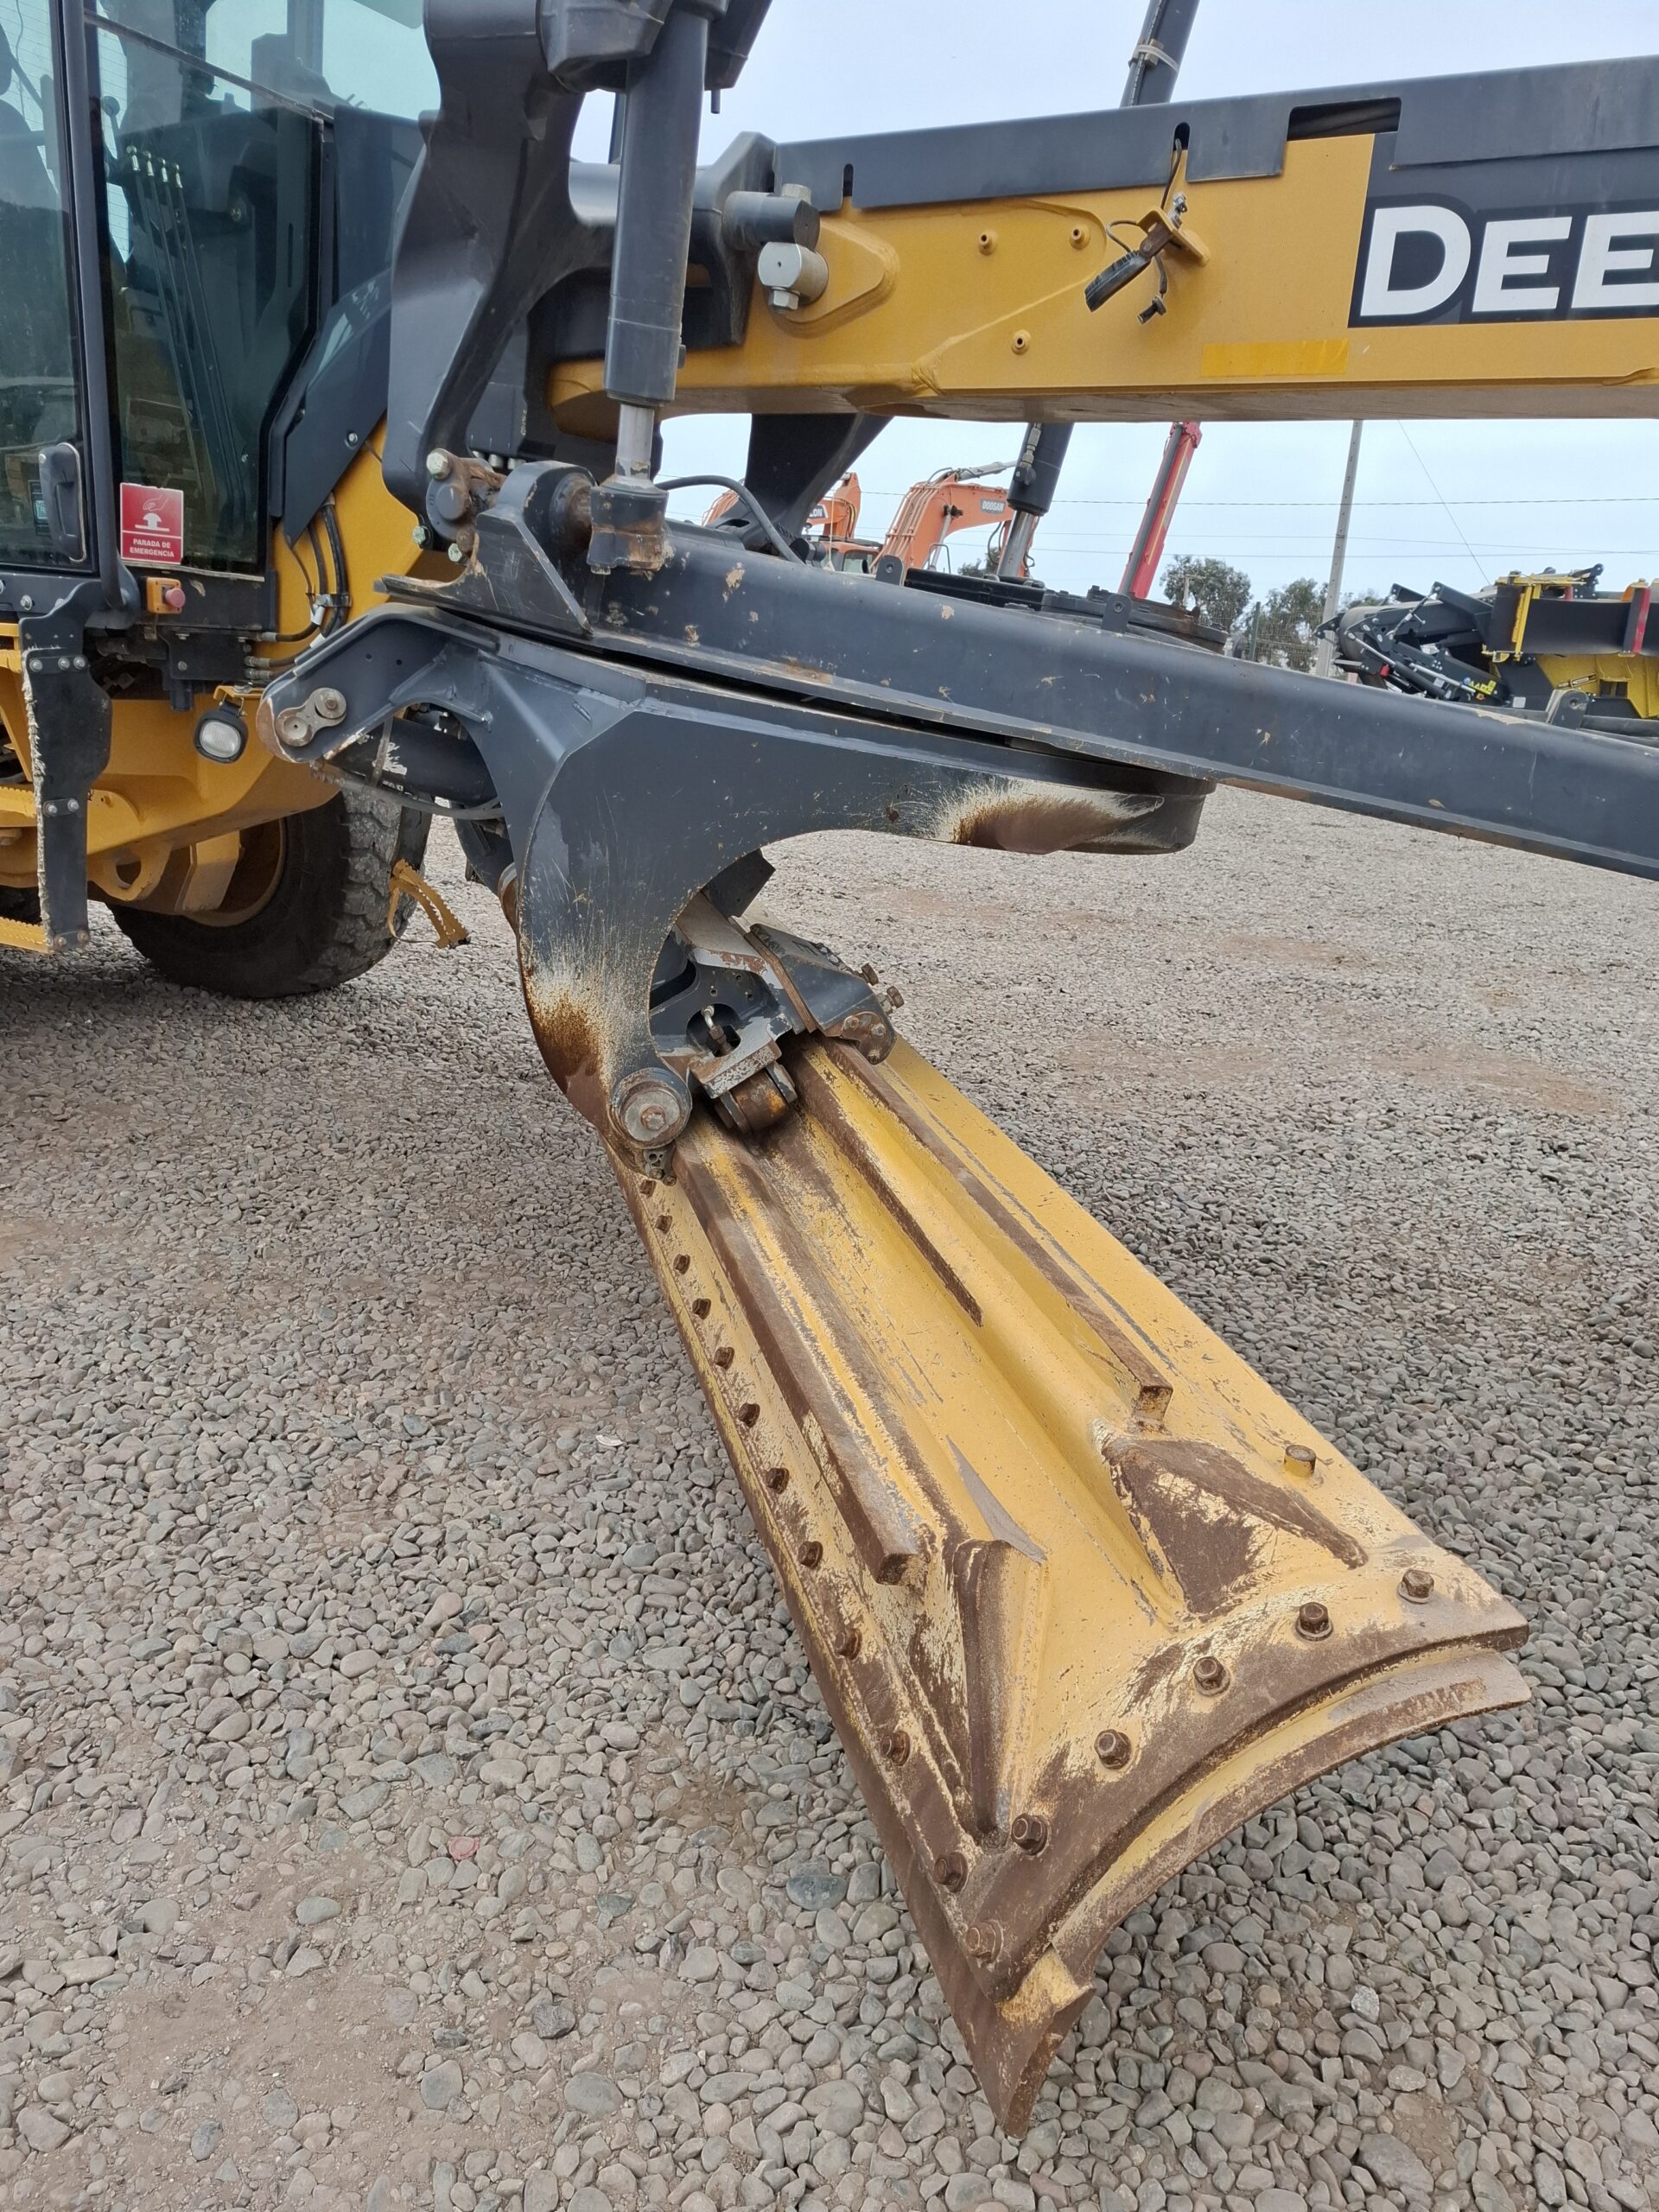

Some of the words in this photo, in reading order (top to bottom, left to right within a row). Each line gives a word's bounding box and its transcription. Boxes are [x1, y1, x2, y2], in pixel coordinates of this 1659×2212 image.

[1360, 205, 1659, 316] DEE
[133, 538, 161, 548] PARADA
[130, 547, 175, 557] EMERGENCIA
